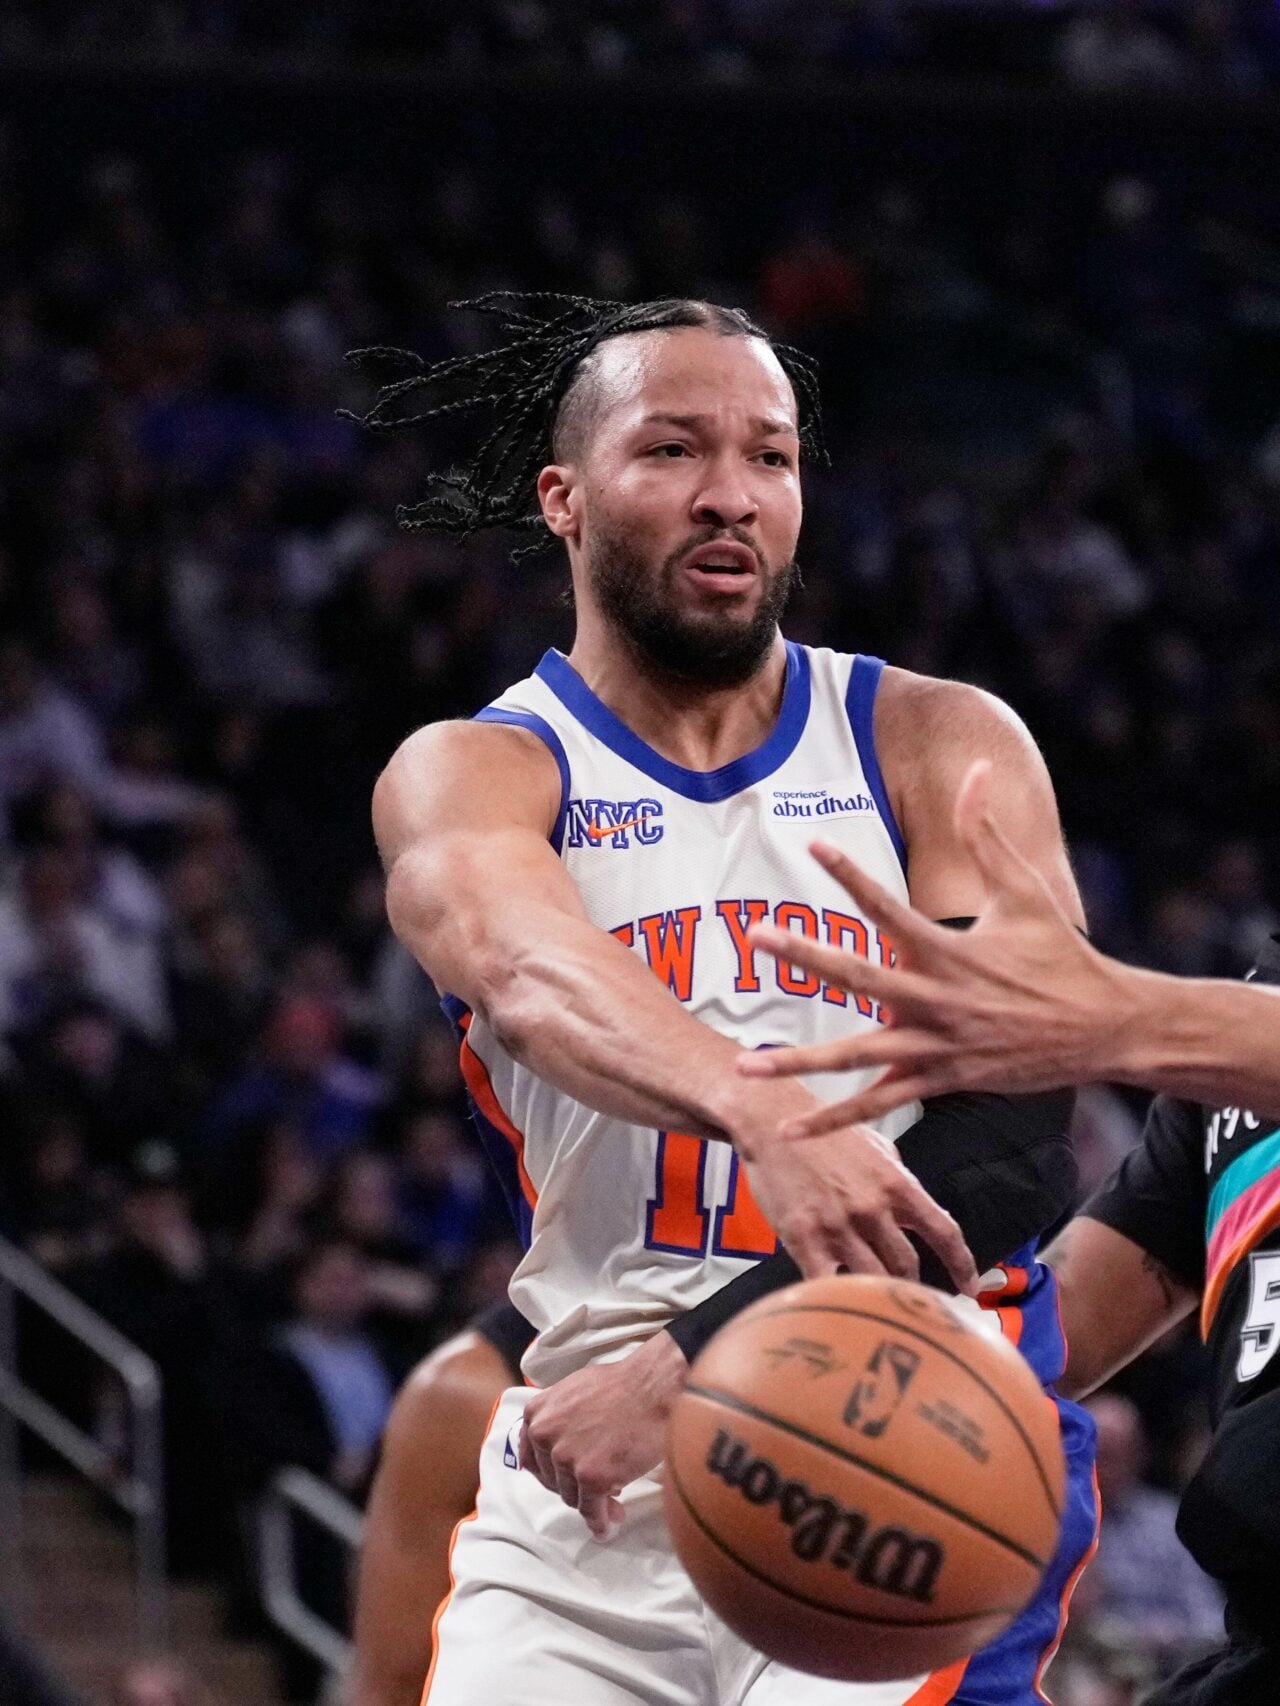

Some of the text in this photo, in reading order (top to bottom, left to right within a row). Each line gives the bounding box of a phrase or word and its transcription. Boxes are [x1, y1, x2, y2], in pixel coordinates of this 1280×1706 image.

[773, 790, 827, 799] experience
[773, 794, 875, 816] abu dhabi
[567, 798, 663, 849] NYC
[706, 1424, 945, 1604] Wilson
